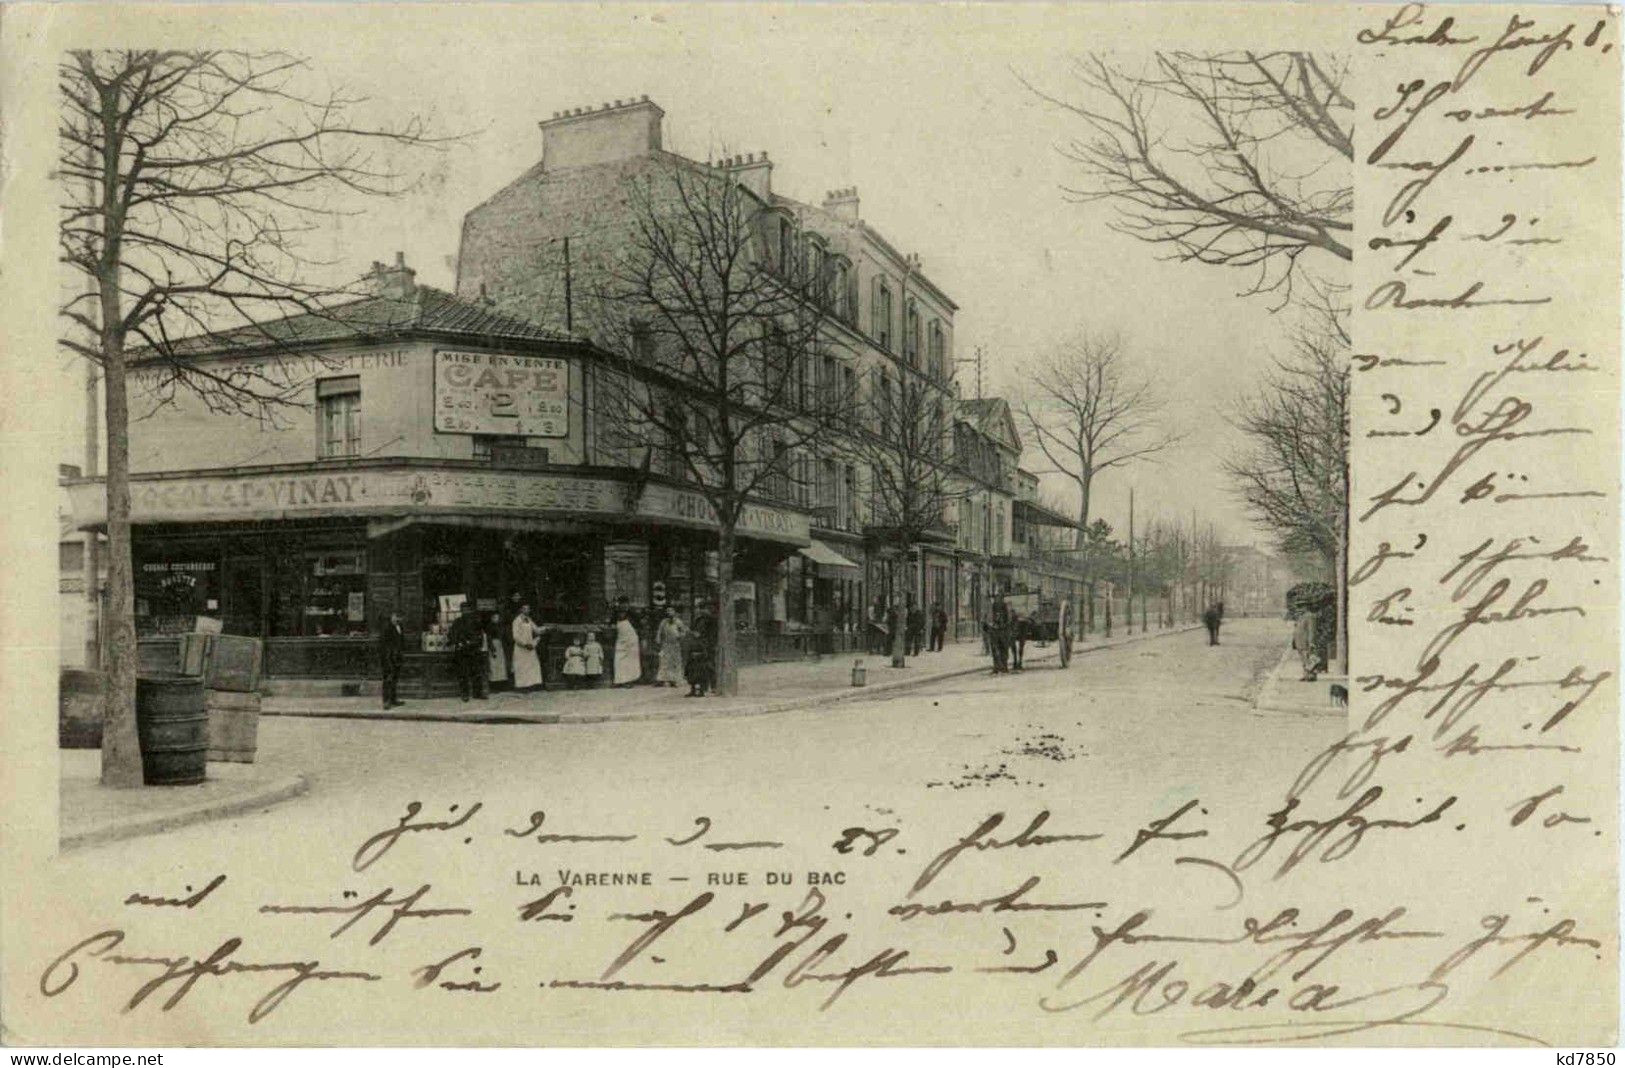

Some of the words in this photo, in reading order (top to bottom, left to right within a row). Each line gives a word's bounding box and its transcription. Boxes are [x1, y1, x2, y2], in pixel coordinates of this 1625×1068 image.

[441, 352, 481, 364] MISE
[488, 357, 509, 367] EN
[515, 359, 564, 370] VENTE
